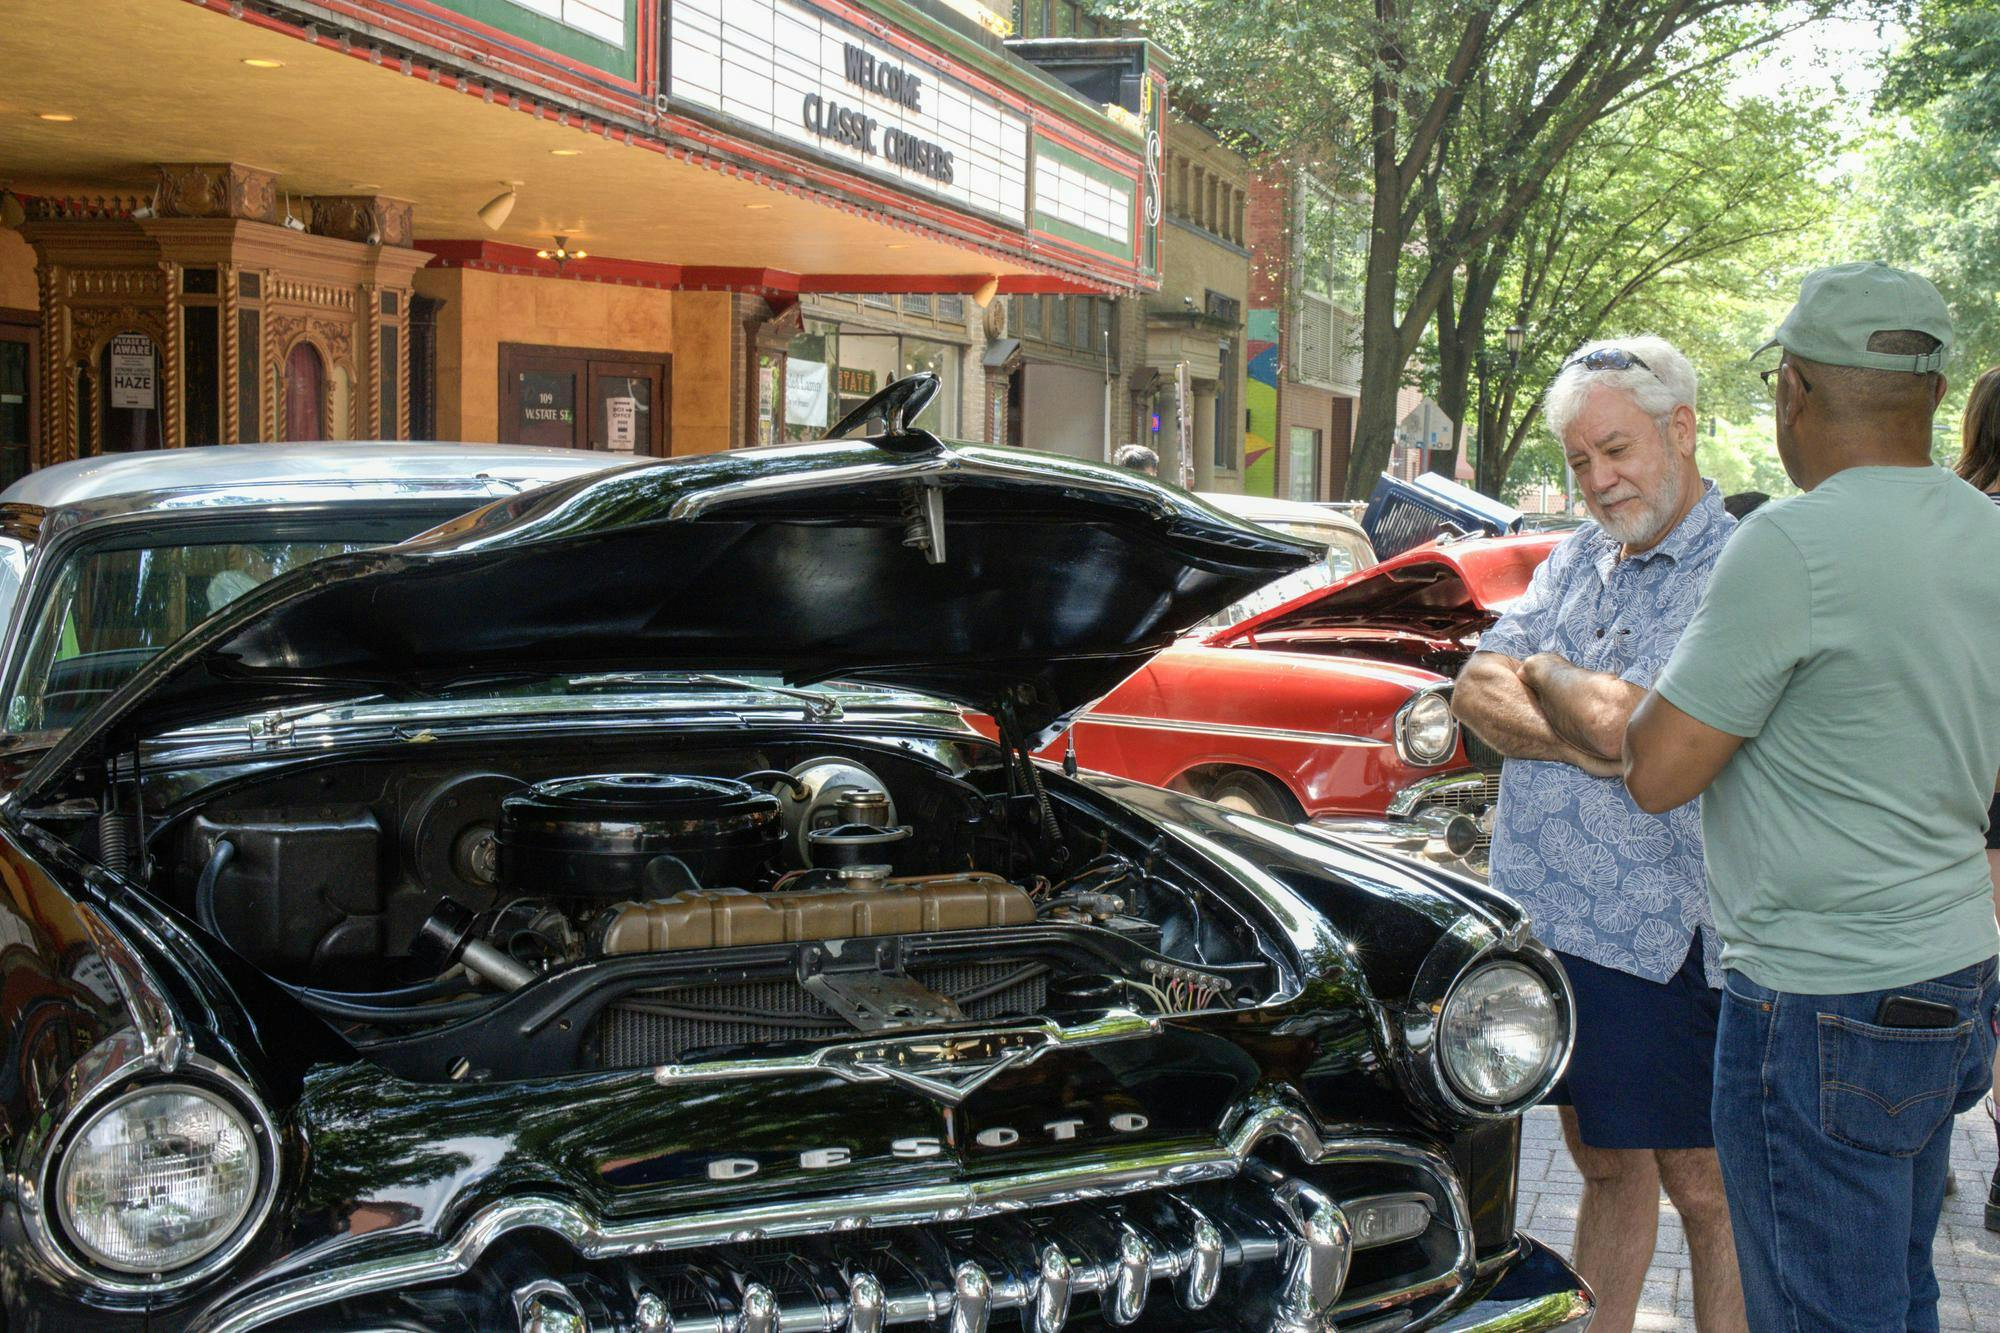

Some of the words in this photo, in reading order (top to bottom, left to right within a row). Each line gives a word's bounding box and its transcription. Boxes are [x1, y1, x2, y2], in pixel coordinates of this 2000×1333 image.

[844, 42, 921, 113] WELCOME
[803, 92, 877, 155] CLASSIC
[884, 126, 954, 184] CRUISERS
[113, 337, 140, 345] PLEASE
[114, 345, 152, 355] AWARE
[115, 376, 152, 389] HAZE
[539, 392, 553, 404] 109
